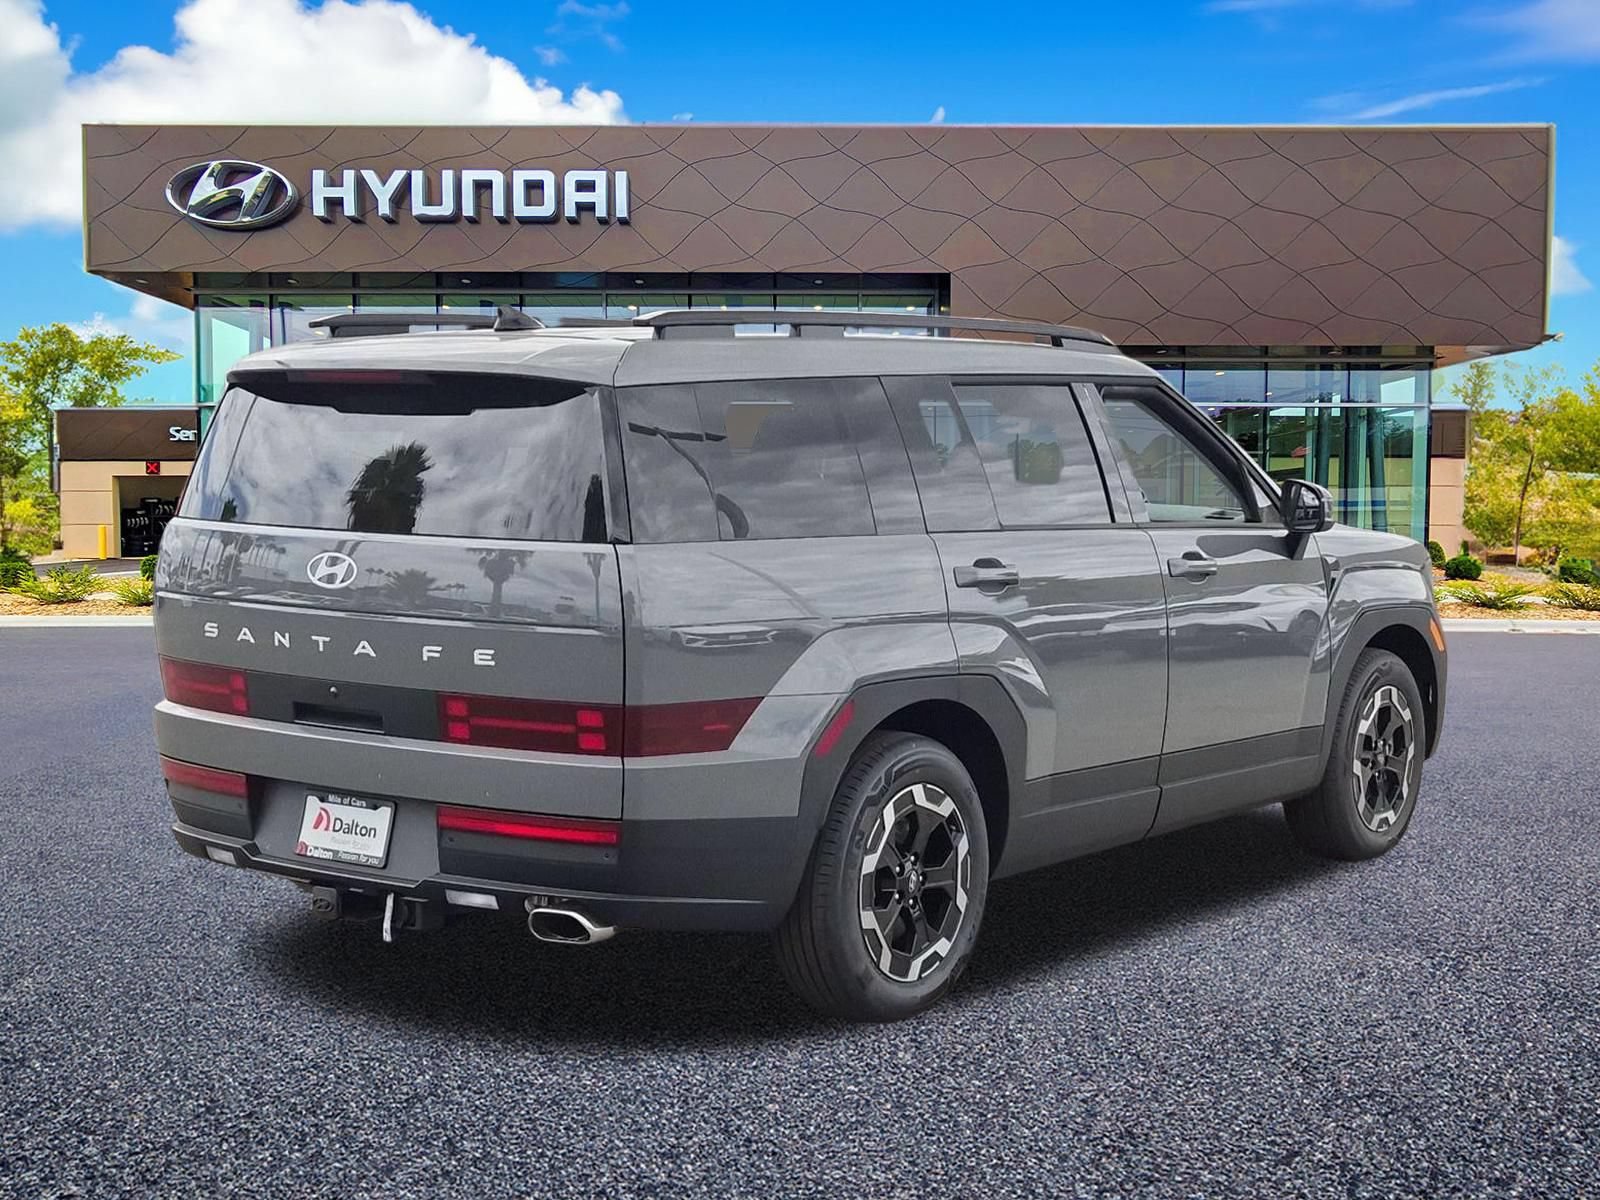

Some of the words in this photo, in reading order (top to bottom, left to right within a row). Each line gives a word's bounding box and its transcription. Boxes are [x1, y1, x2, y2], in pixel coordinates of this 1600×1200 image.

[312, 169, 631, 223] HYUNDAI
[203, 622, 377, 657] SANTA
[421, 645, 496, 666] FE
[350, 797, 367, 807] Cars
[332, 817, 377, 838] Dalton
[307, 846, 334, 860] Dalton
